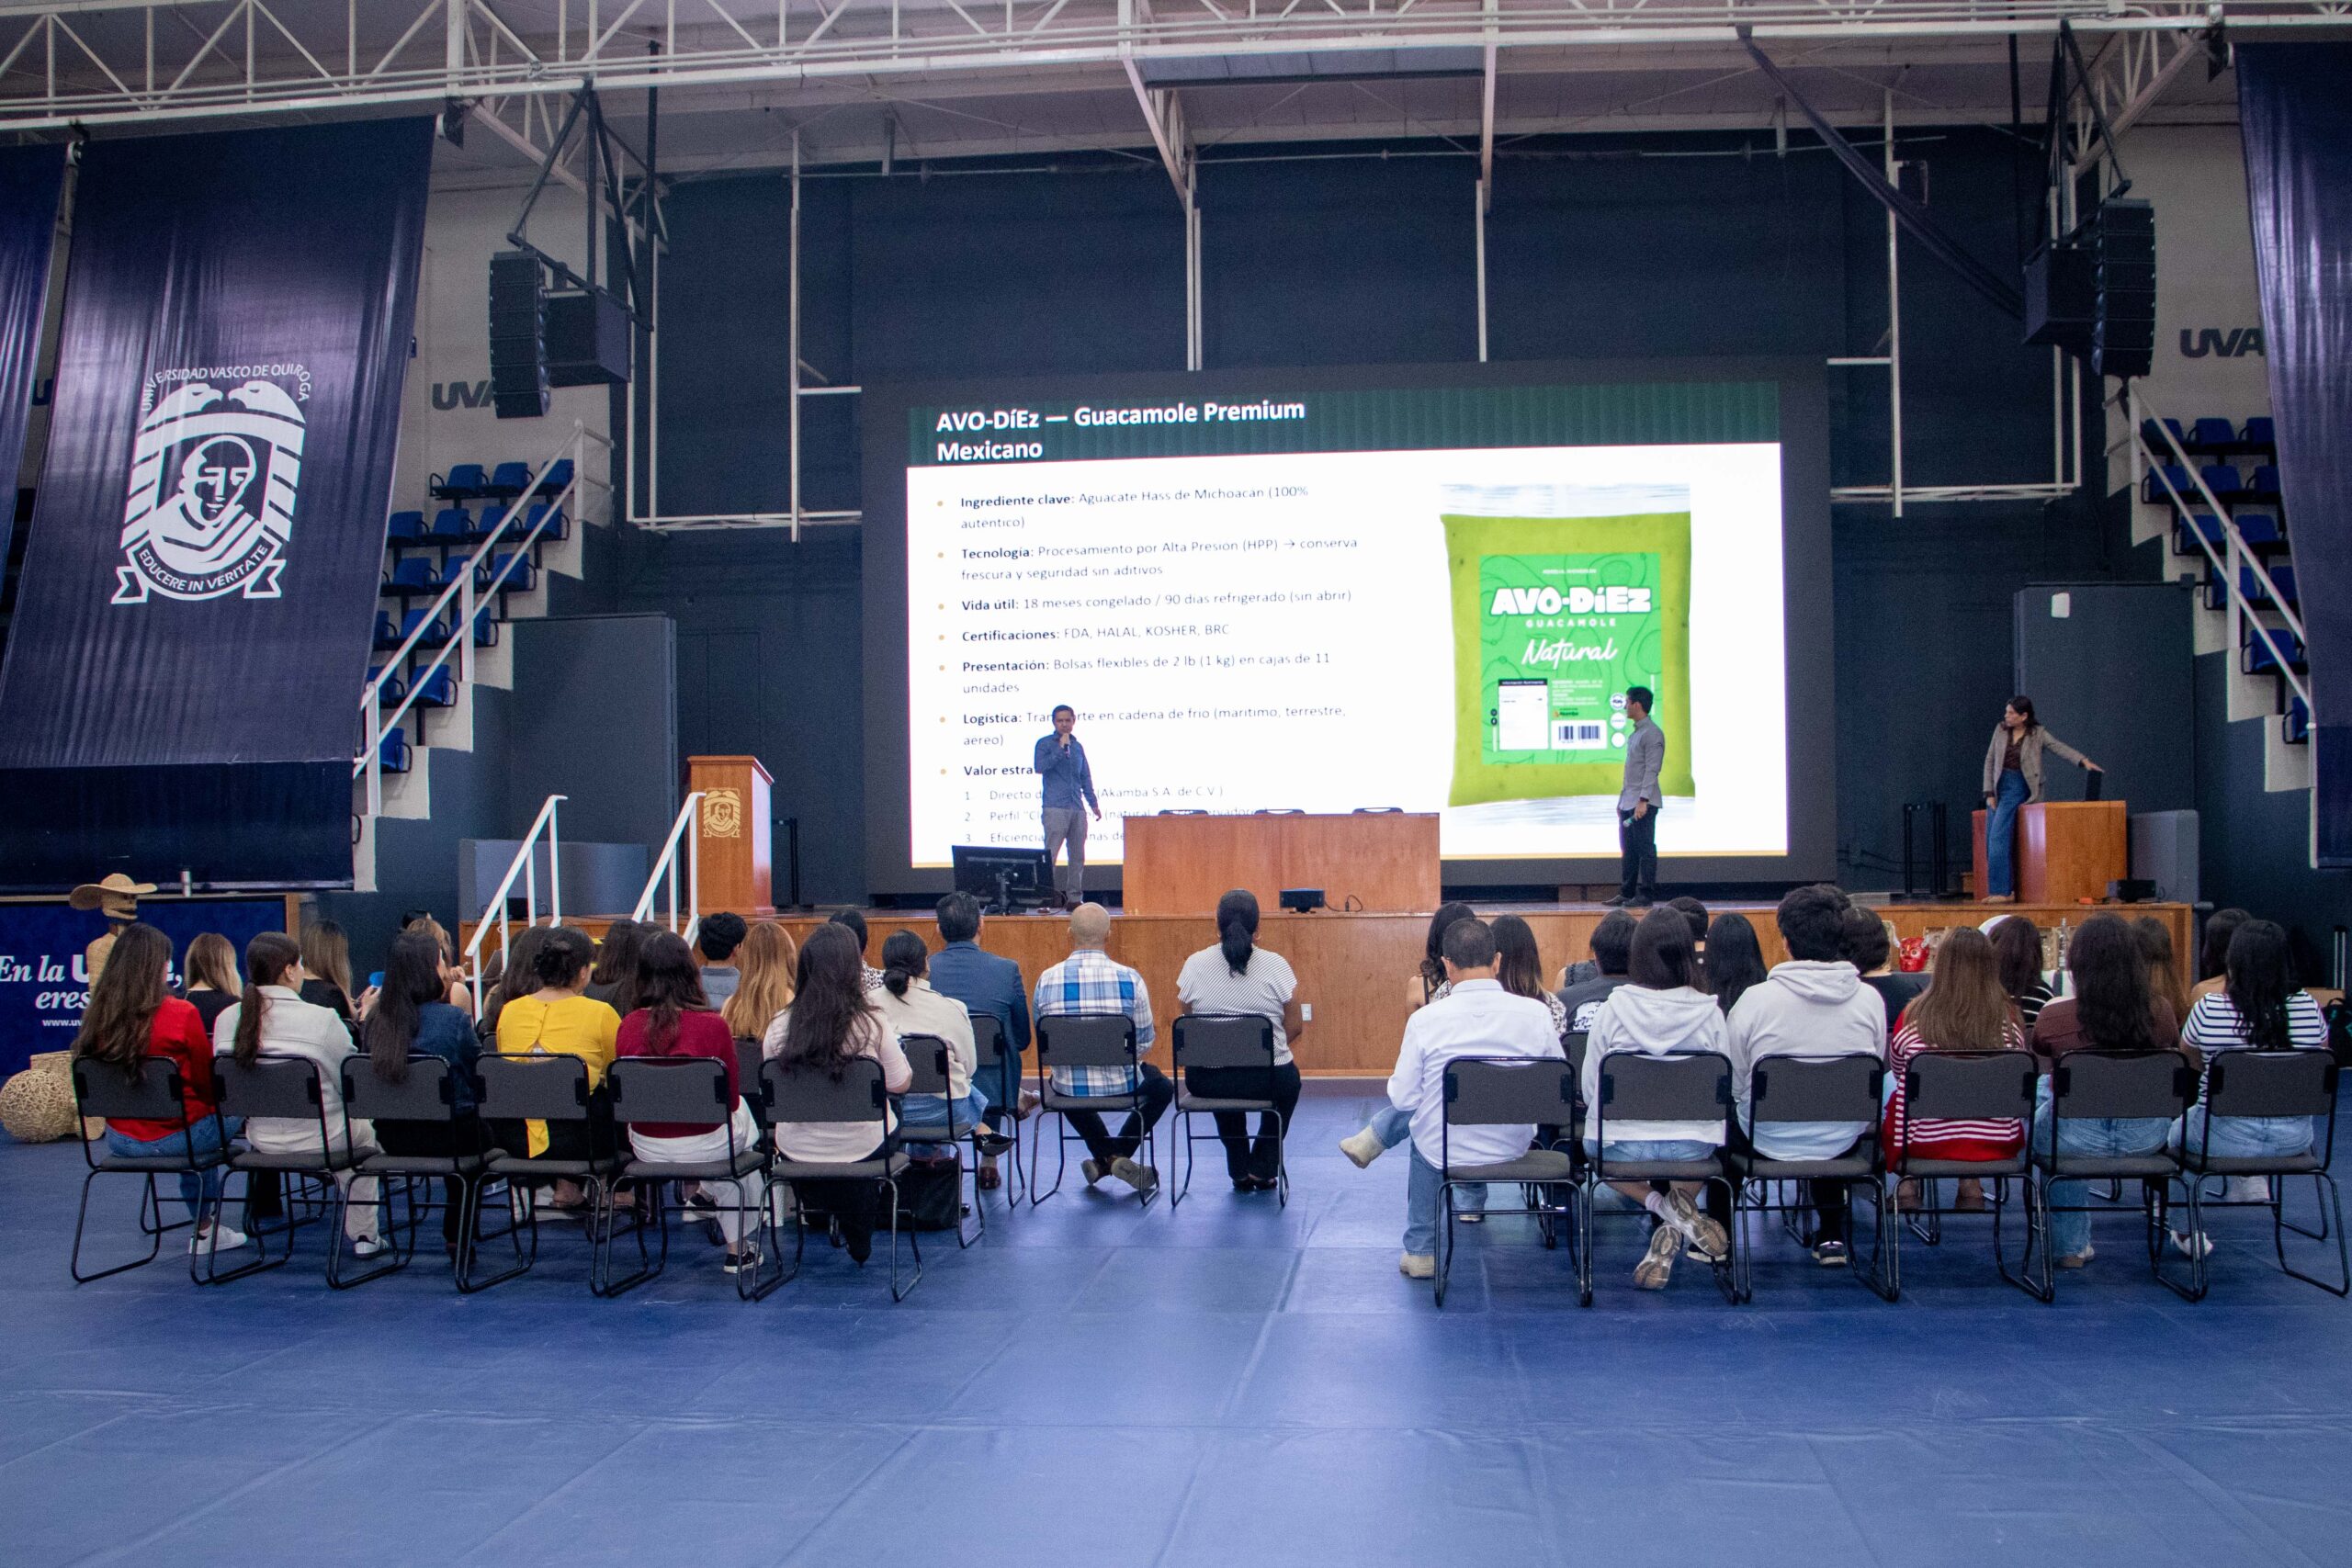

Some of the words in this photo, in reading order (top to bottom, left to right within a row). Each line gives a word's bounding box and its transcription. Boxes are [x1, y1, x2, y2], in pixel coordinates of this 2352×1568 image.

[141, 367, 209, 412] UNIVERSIDAD
[209, 366, 251, 379] VASCO
[252, 365, 269, 378] DE
[271, 363, 311, 402] QUIROGA
[1074, 403, 1198, 426] Guacamole
[1204, 400, 1306, 422] Premium
[937, 440, 1044, 462] Mexicano
[960, 495, 1035, 510] Ingrediente
[1037, 493, 1075, 505] clave:
[1079, 492, 1137, 506] Aguacate
[1141, 491, 1171, 502] Hass
[1175, 490, 1192, 501] de
[1268, 486, 1309, 500] (100%
[1038, 545, 1133, 557] Procesamiento
[1136, 546, 1158, 557] por
[1161, 542, 1187, 553] Alta
[1242, 539, 1278, 552] (HPP)
[1300, 539, 1358, 549] conserva
[139, 548, 187, 591] EDUCERE
[187, 581, 204, 592] IN
[207, 544, 268, 590] VERITATE
[961, 570, 1012, 581] frescura
[1015, 571, 1023, 581] y
[1026, 566, 1089, 581] seguridad
[1092, 567, 1110, 577] sin
[1114, 565, 1163, 576] aditivos
[961, 599, 990, 611] Vida
[1023, 599, 1039, 610] 18
[1042, 600, 1082, 609] meses
[1086, 595, 1152, 610] congelado
[1165, 594, 1182, 605] 90
[1214, 592, 1286, 606] refrigerado
[1290, 591, 1313, 604] (sin
[1317, 590, 1351, 603] abrir)
[1525, 618, 1617, 628] GUACAMOLE
[962, 629, 1060, 642] Certificaciones:
[1064, 628, 1093, 640] FDA,
[1097, 626, 1141, 638] HALAL,
[1146, 625, 1201, 637] KOSHER,
[1204, 624, 1229, 636] BRC
[963, 660, 1050, 673] Presentación:
[1054, 659, 1093, 671] Bolsas
[1097, 657, 1148, 669] flexibles
[1152, 656, 1169, 667] de
[1172, 656, 1180, 667] 2
[1184, 655, 1196, 667] lb
[1199, 655, 1212, 669] (1
[1216, 654, 1236, 669] kg)
[1239, 657, 1255, 665] en
[1259, 656, 1291, 668] cajas
[1295, 653, 1311, 664] de
[1316, 653, 1330, 664] 11
[1521, 637, 1619, 671] Natural
[963, 682, 1020, 694] unidades
[1099, 712, 1114, 721] en
[1118, 709, 1165, 720] cadena
[1169, 708, 1184, 719] de
[964, 765, 999, 776] Valor
[989, 790, 1032, 801] Directo
[1178, 785, 1193, 797] de
[989, 810, 1020, 821] Perfil
[38, 955, 65, 983] la
